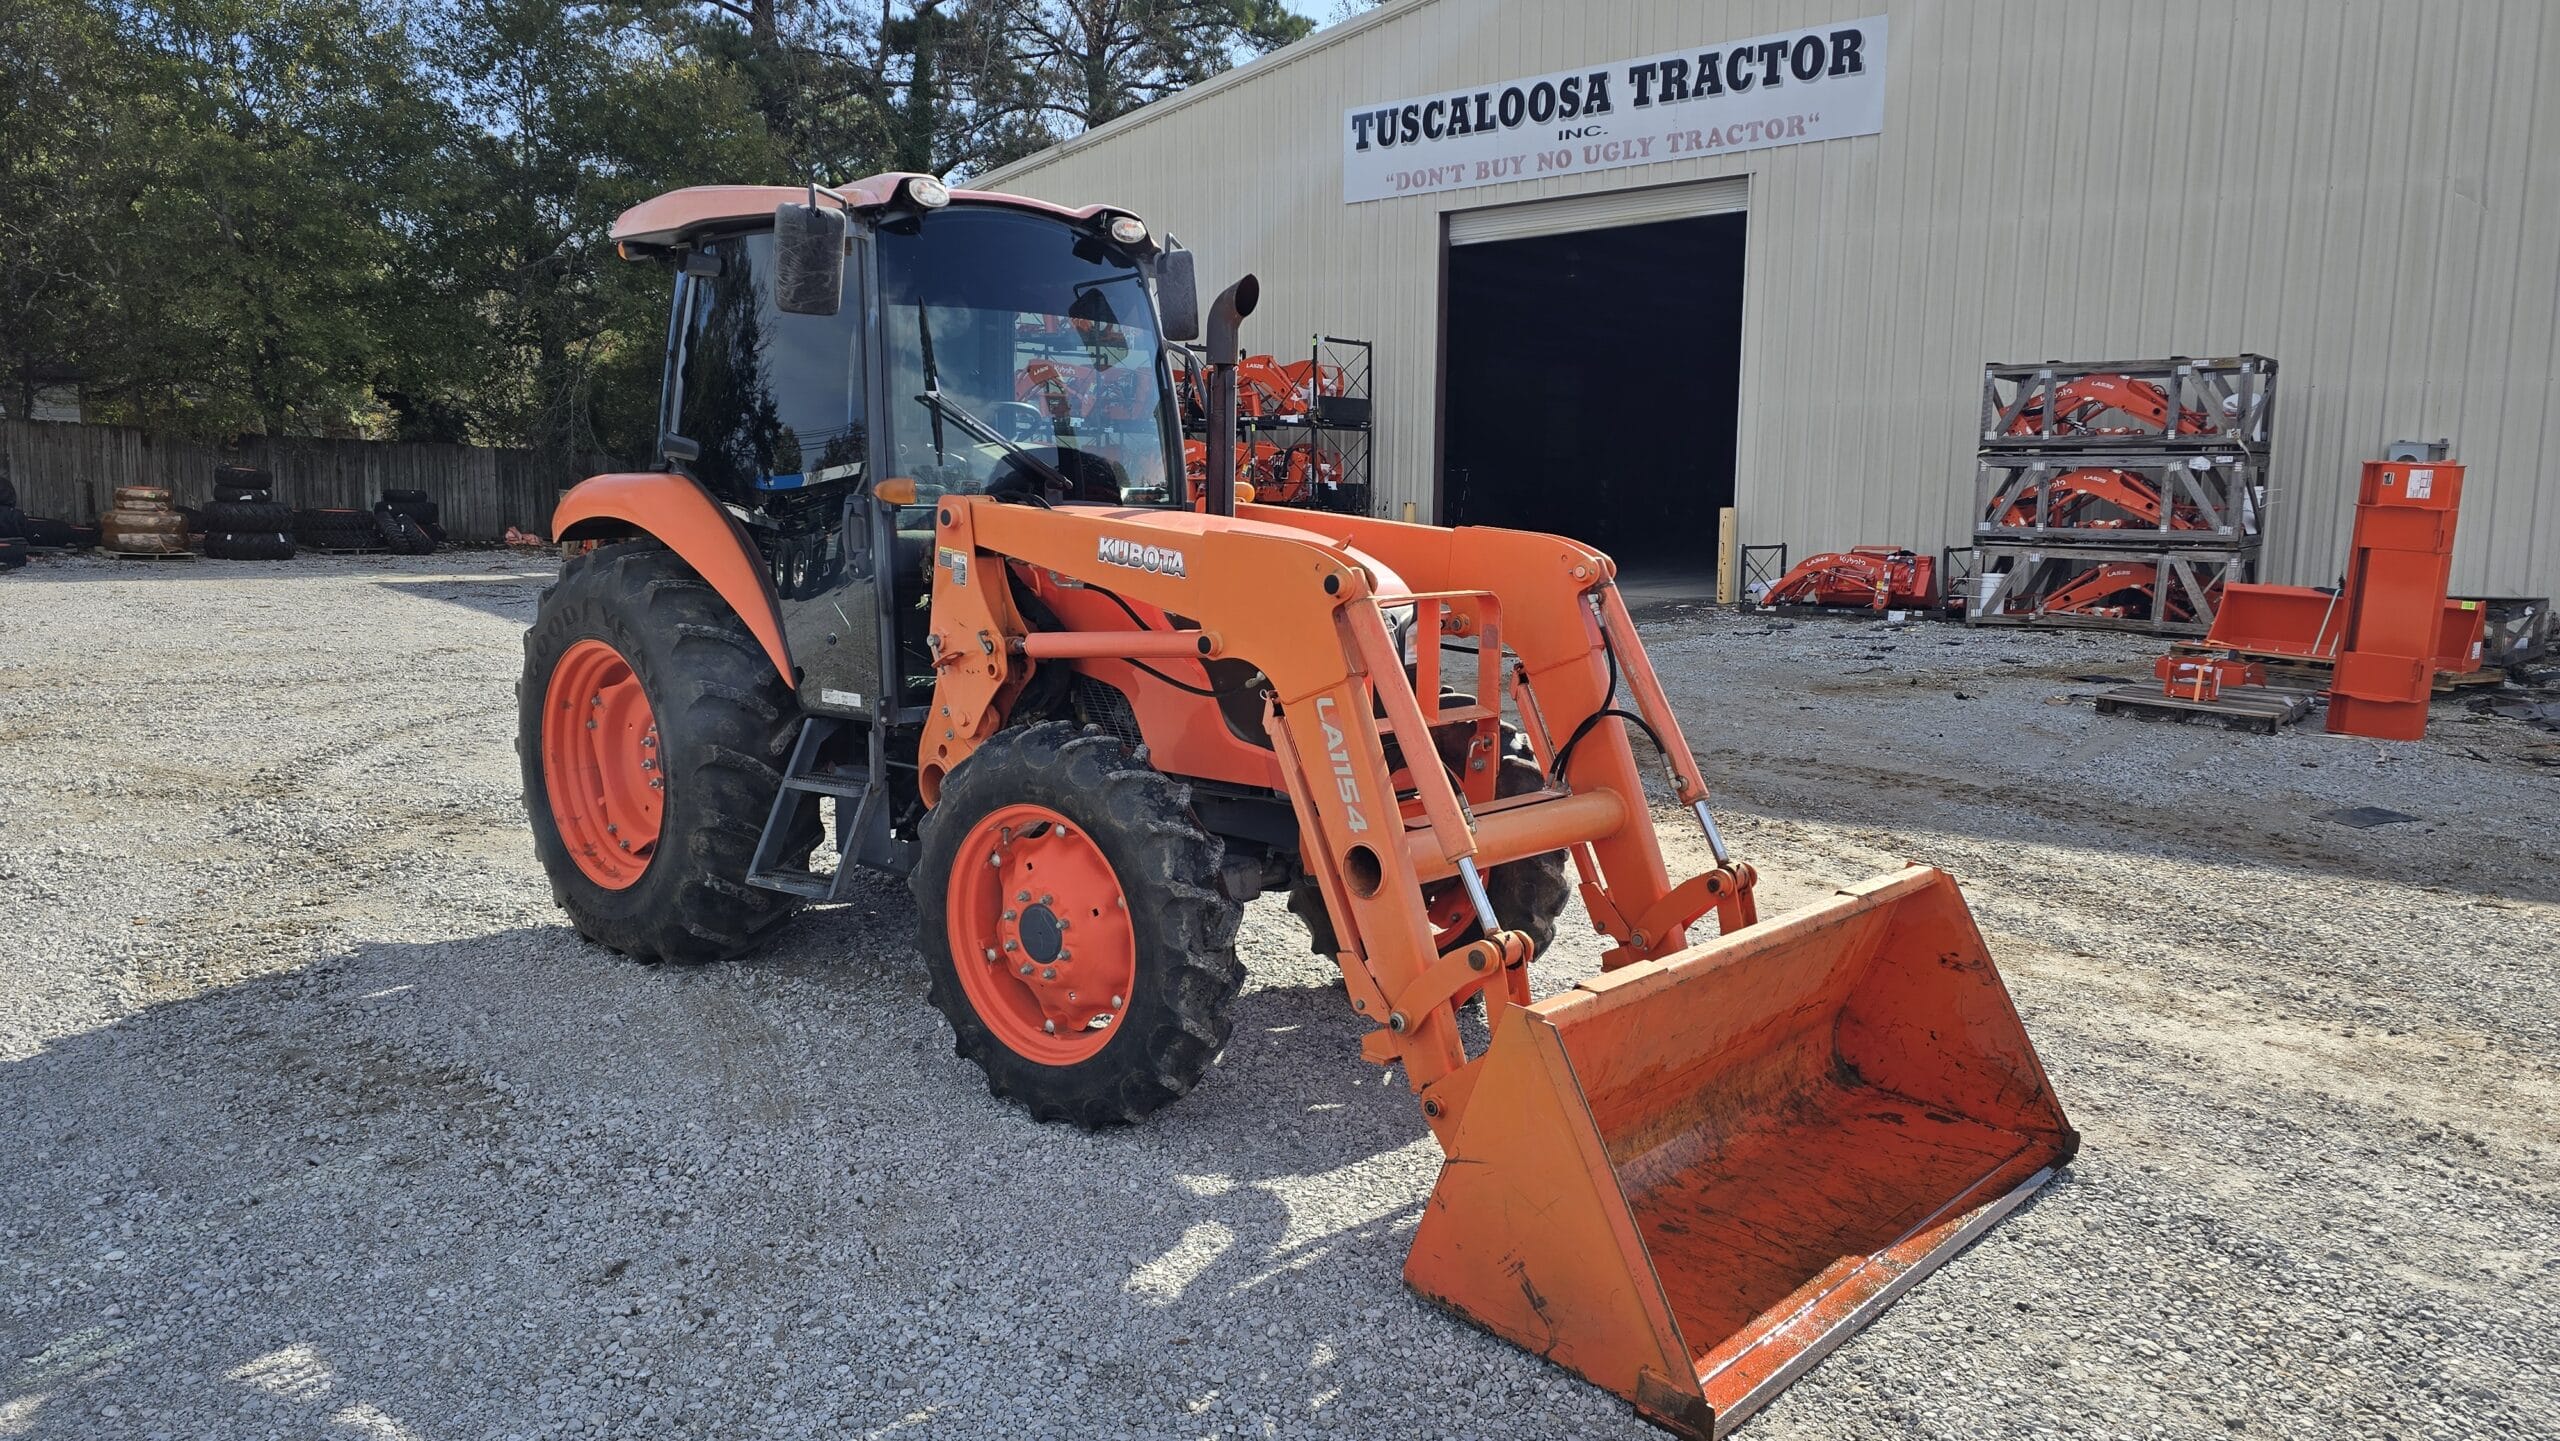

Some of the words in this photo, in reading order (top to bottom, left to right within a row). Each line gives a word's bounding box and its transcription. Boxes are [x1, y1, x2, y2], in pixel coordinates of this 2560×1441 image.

[1352, 71, 1613, 152] TUSCALOOSA
[1628, 29, 1865, 108] TRACTOR
[1558, 125, 1608, 141] INC.
[1475, 154, 1527, 181] BUY
[1537, 149, 1573, 173] NO
[1583, 135, 1656, 165] UGLY
[1098, 536, 1186, 580] KUBOTA
[1316, 697, 1369, 833] LA1154
